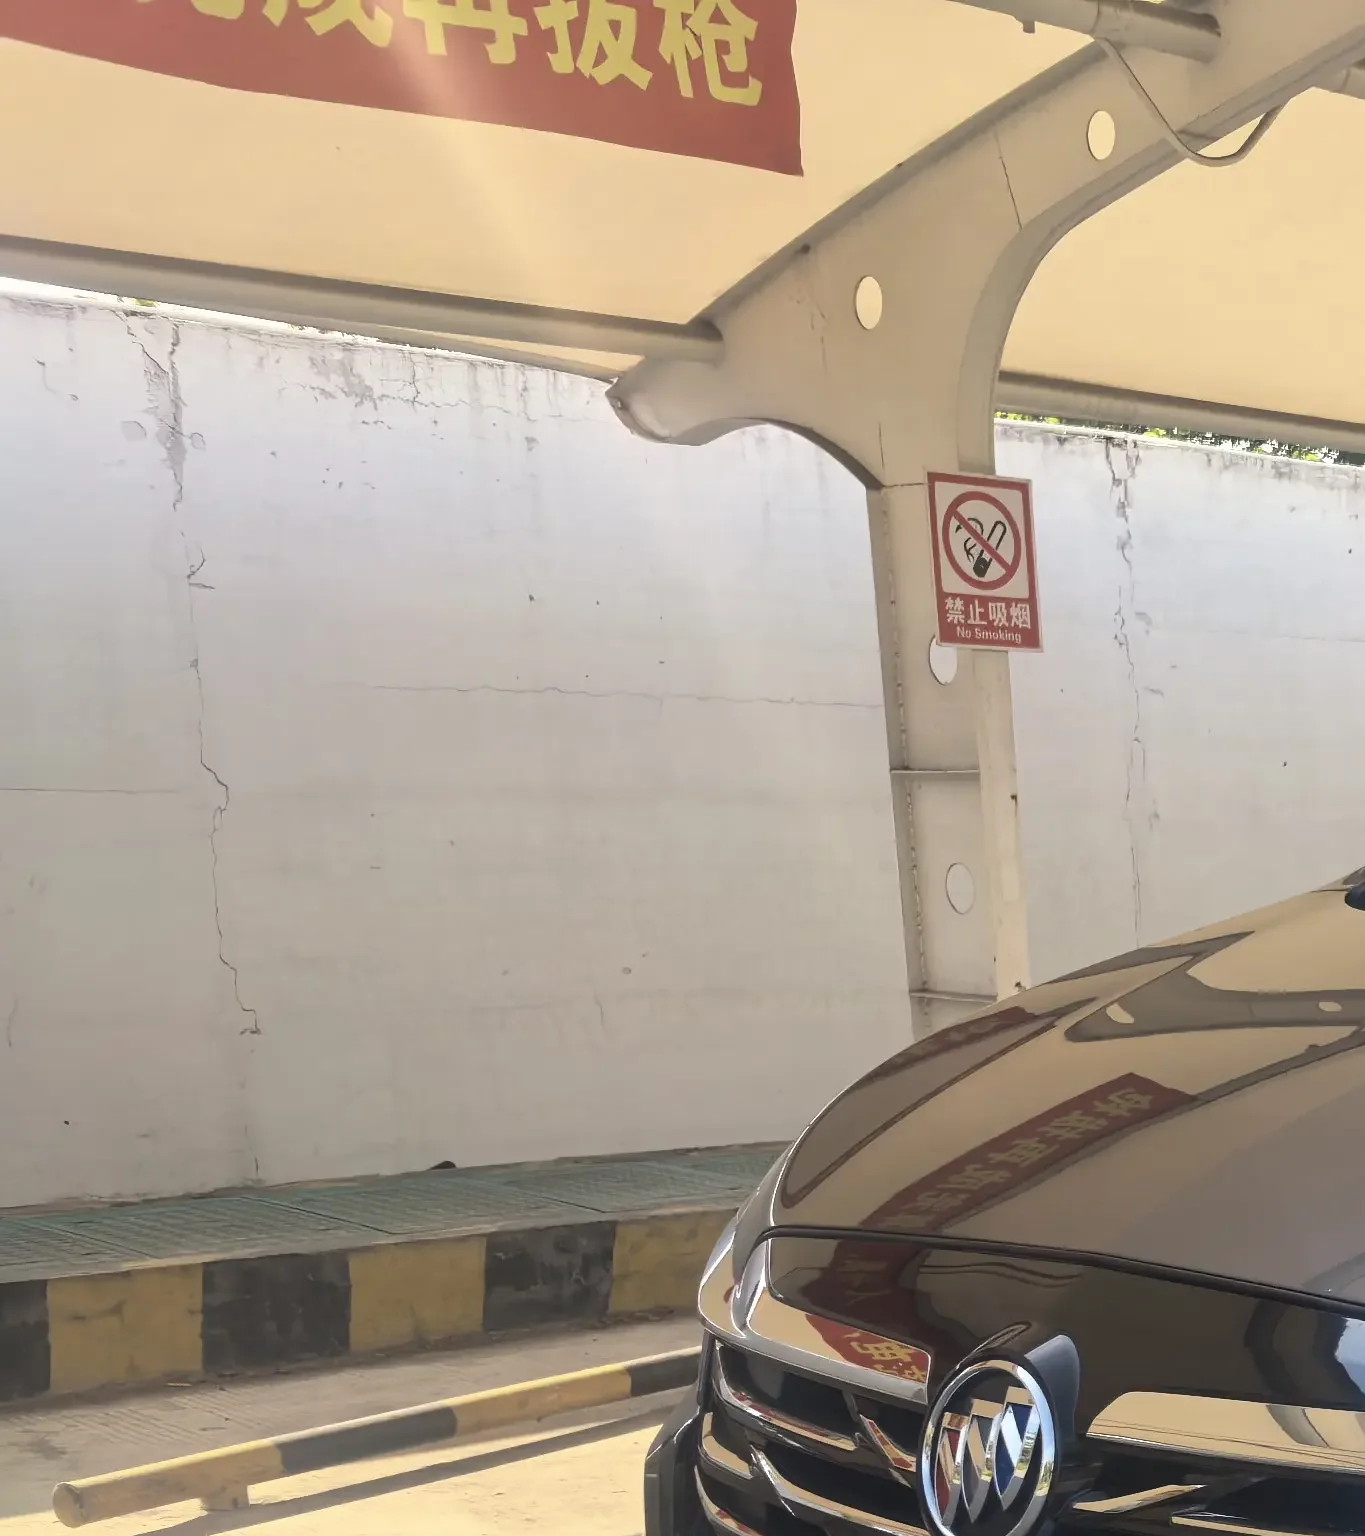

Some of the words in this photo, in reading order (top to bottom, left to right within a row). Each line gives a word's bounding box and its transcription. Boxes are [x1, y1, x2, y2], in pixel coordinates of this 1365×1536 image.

[136, 0, 763, 107] 再拔枪
[945, 597, 1031, 629] 禁止吸烟
[956, 626, 971, 639] No
[974, 628, 1022, 643] Smoking
